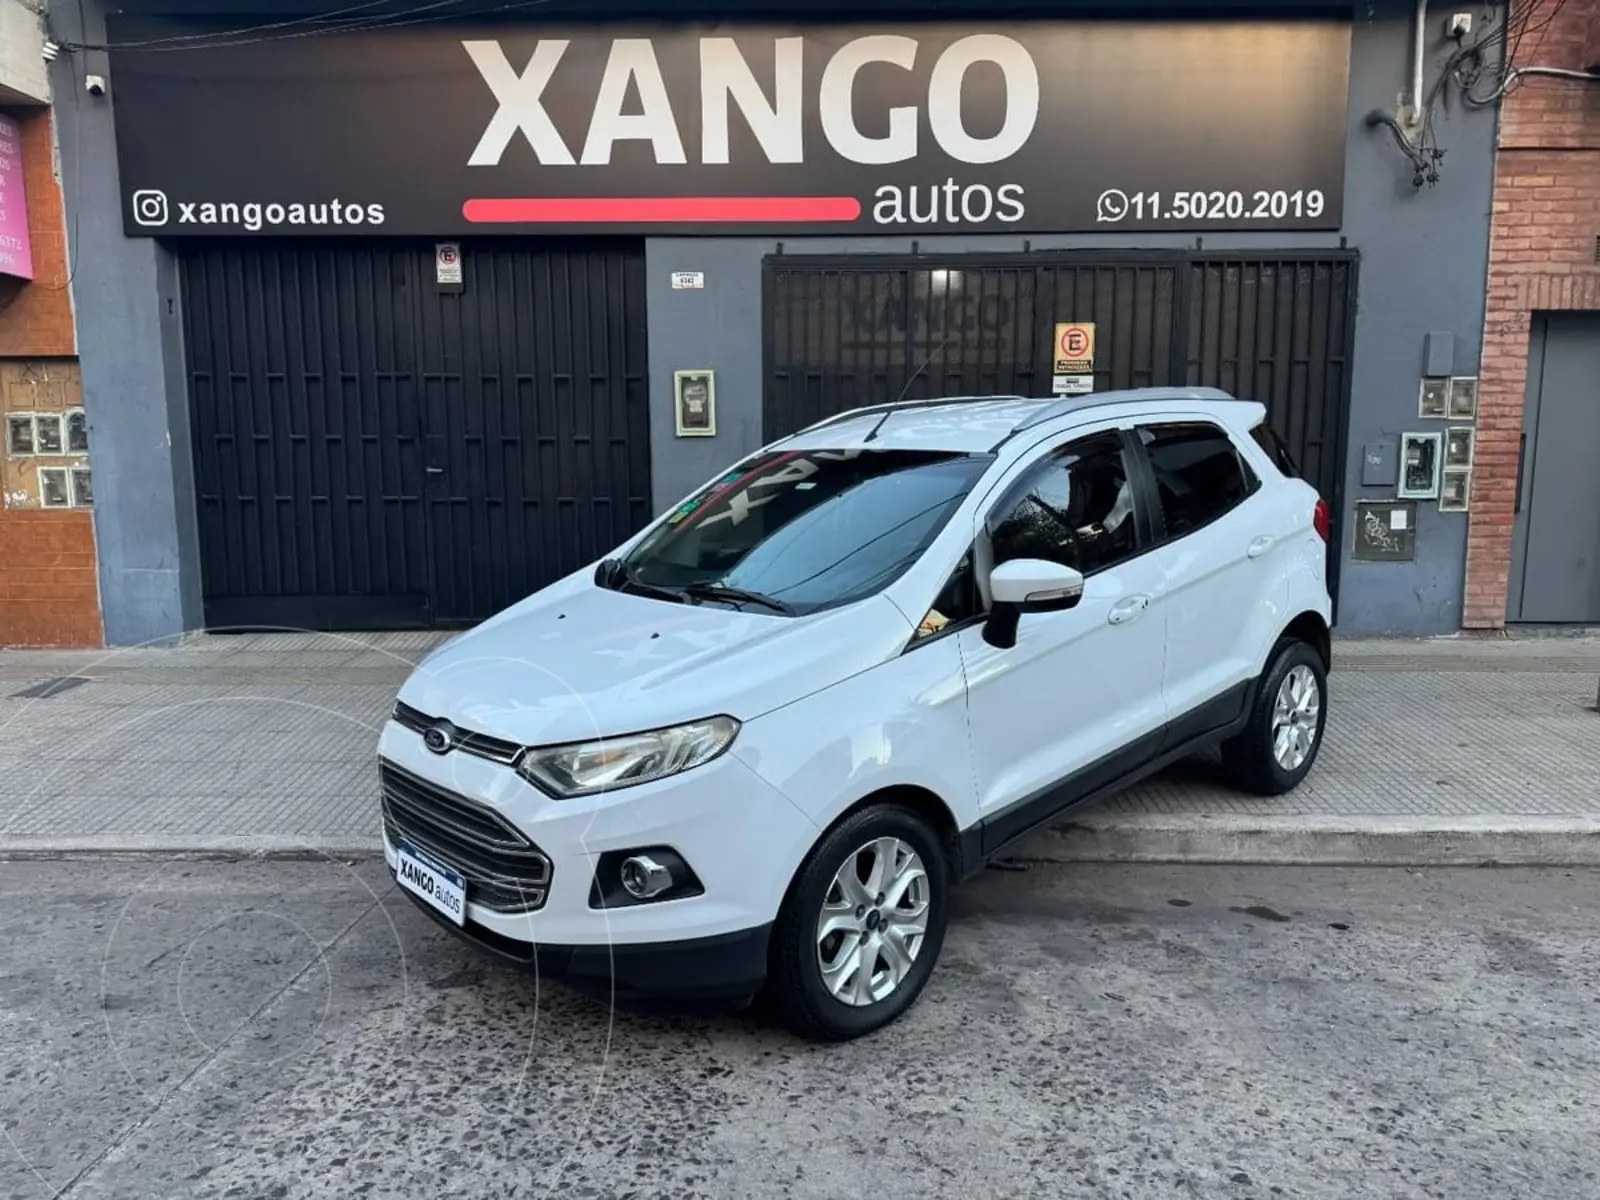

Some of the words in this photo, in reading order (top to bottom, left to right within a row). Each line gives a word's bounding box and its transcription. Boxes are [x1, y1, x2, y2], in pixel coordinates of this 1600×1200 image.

[462, 34, 1040, 166] XANGO
[177, 198, 386, 231] xangoautos
[872, 176, 1025, 225] autos
[1131, 189, 1325, 220] 11.5020.2019
[435, 885, 460, 914] autos
